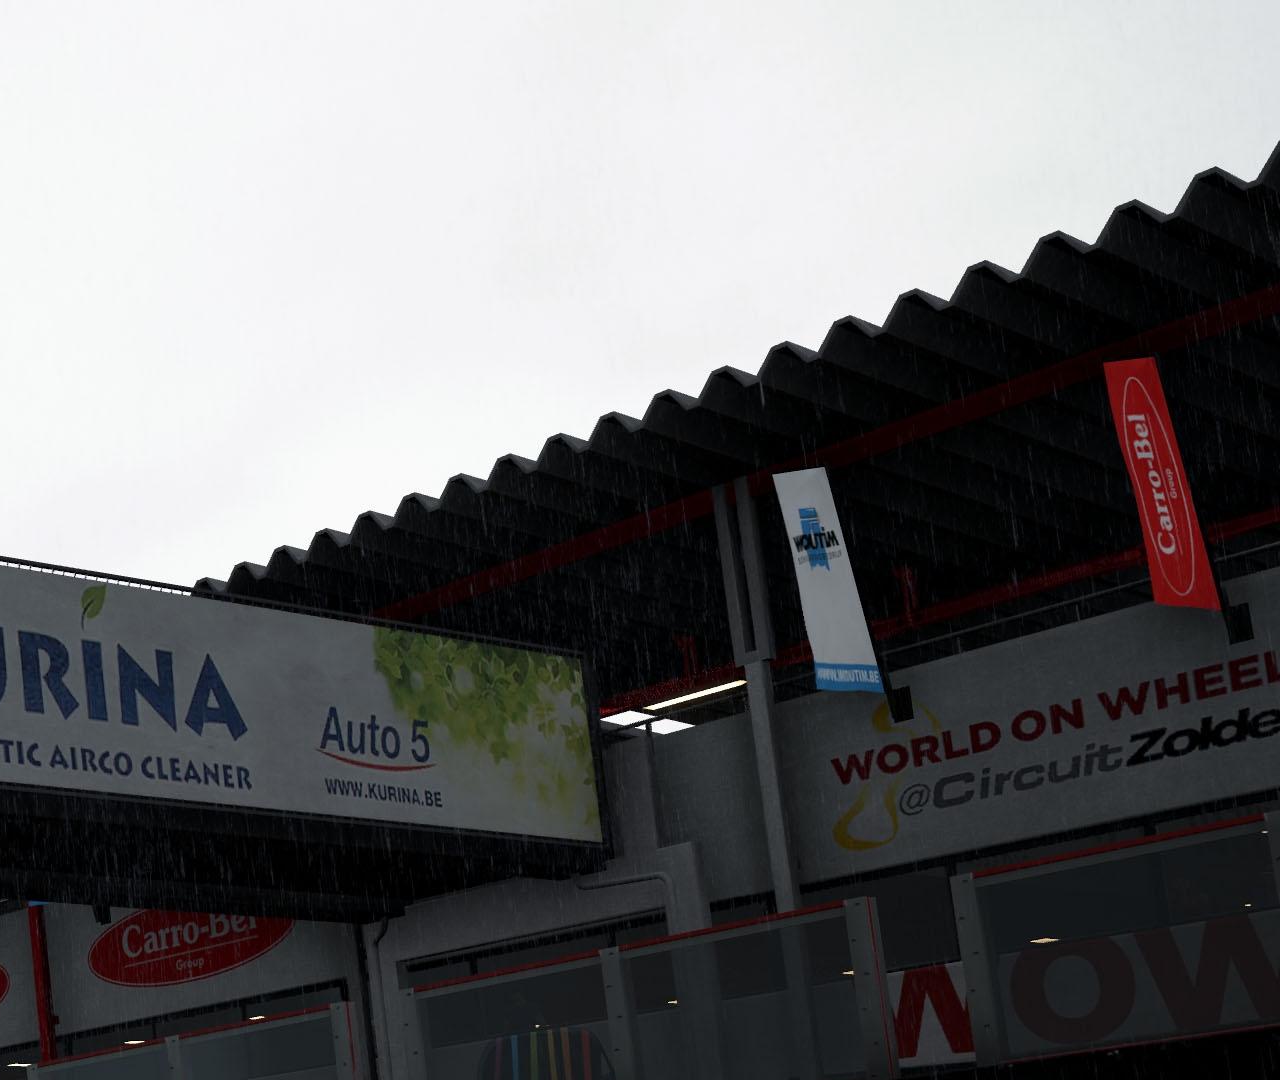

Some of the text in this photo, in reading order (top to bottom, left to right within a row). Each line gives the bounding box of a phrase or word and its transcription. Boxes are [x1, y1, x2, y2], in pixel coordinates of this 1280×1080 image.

[1127, 413, 1177, 555] Carro-Bel
[320, 706, 430, 763] Auto 5
[831, 720, 1002, 786] WORLD
[1011, 697, 1084, 742] ON
[48, 743, 133, 778] AIRCO
[140, 757, 253, 791] CLEANER
[324, 778, 443, 808] WWW.KURINA.BE
[176, 957, 205, 971] Group
